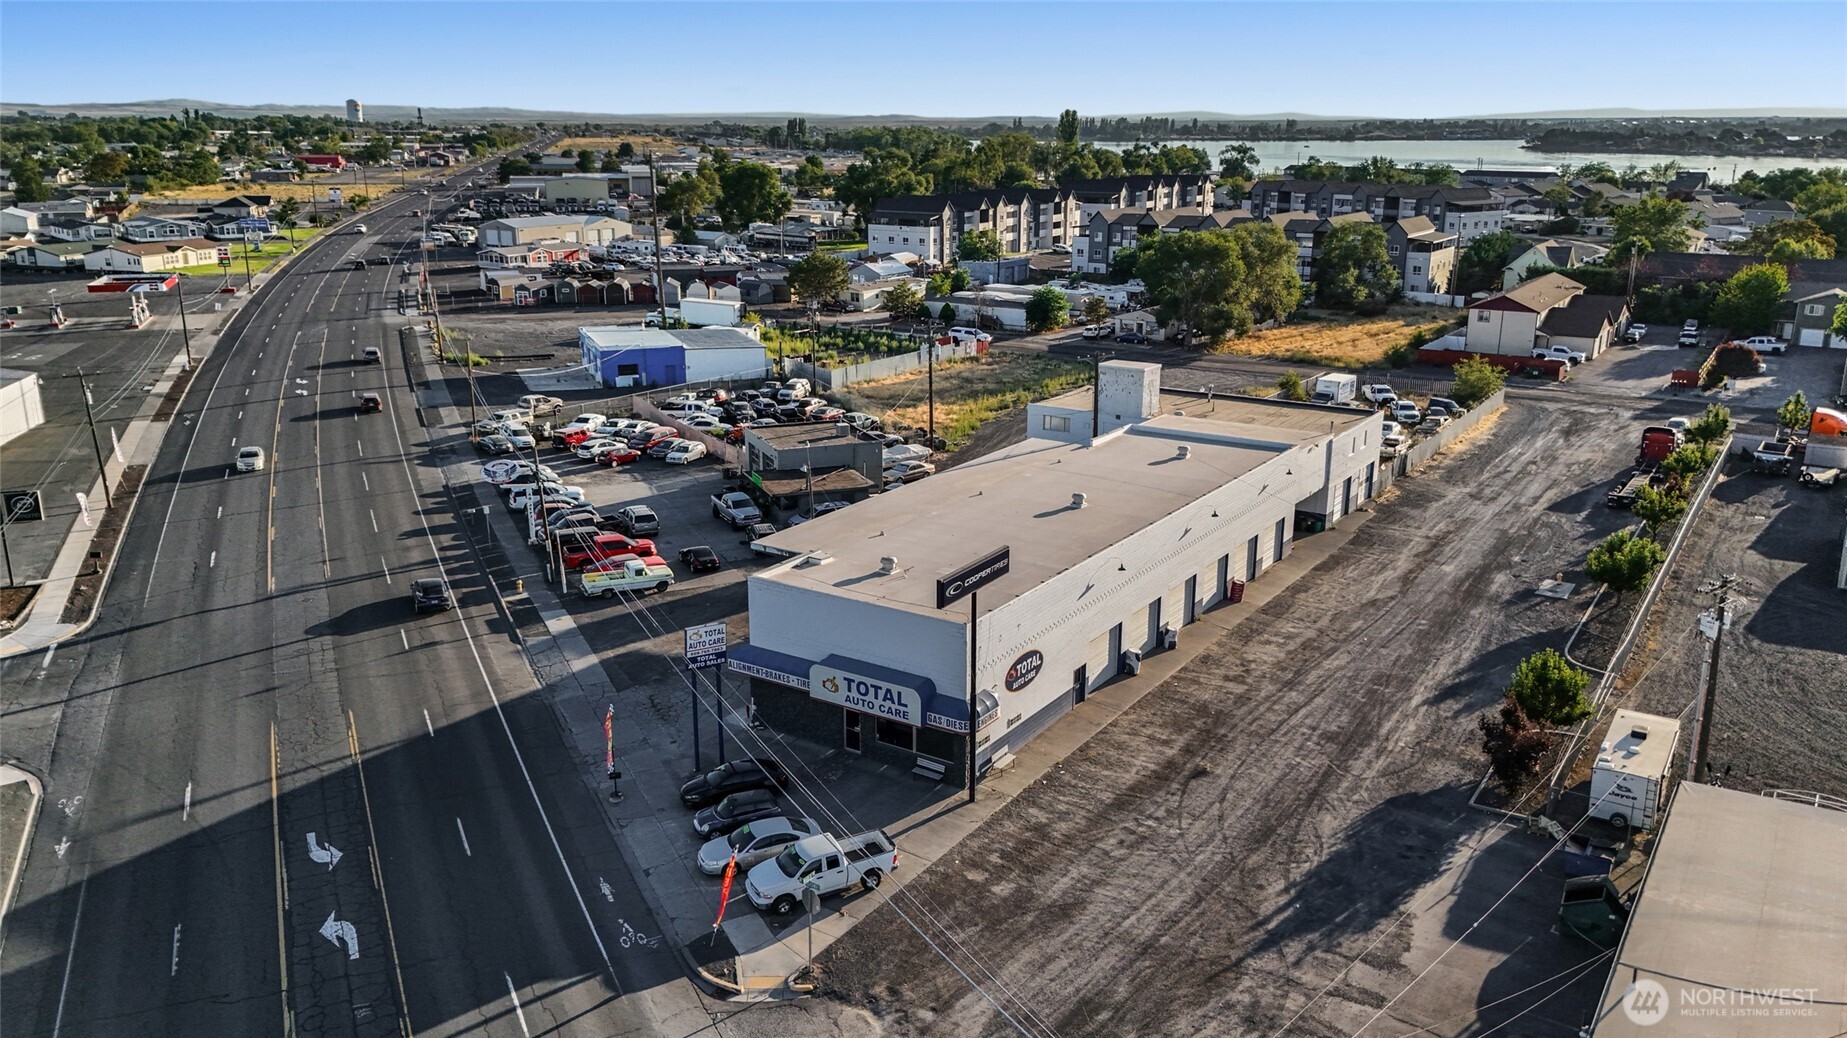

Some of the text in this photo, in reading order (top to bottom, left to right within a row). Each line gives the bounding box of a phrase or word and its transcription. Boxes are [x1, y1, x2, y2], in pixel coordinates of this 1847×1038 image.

[704, 628, 725, 638] TOTAL
[688, 637, 725, 650] AUTO CARE
[688, 658, 726, 670] AUTO SALES
[696, 654, 717, 662] TOTAL
[1016, 653, 1042, 677] TOTAL
[796, 678, 811, 690] TIRE
[1012, 669, 1036, 690] AUTO CARE
[843, 676, 909, 709] TOTAL
[845, 694, 910, 720] AUTO CARE
[927, 713, 969, 731] GAS/DIESE
[1608, 790, 1638, 801] Jayco
